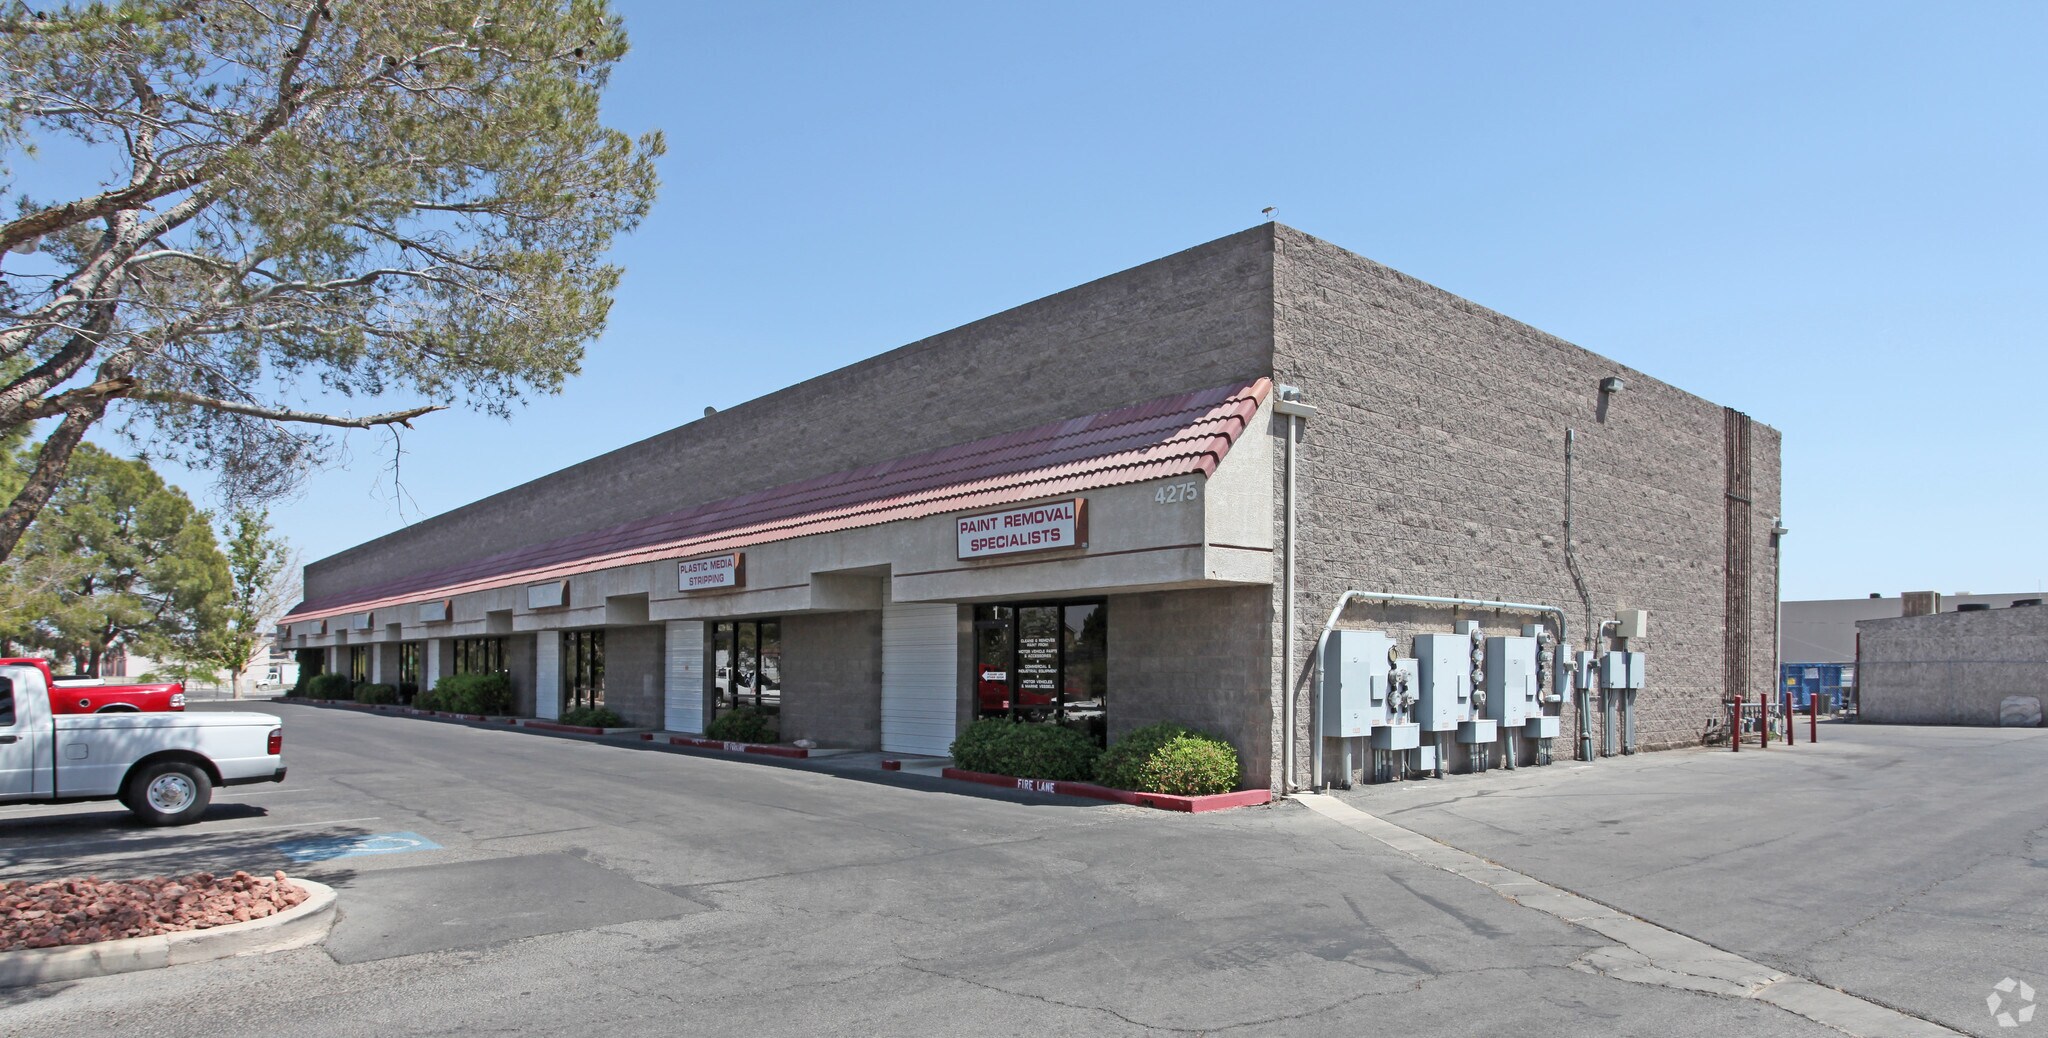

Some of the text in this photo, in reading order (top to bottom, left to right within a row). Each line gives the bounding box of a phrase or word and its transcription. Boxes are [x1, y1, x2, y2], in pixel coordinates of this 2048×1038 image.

[1155, 481, 1198, 505] 4275
[960, 506, 1073, 534] PAINT REMOVAL
[971, 528, 1060, 551] SPECIALISTS
[680, 558, 733, 574] PLASTIC MEDIA
[689, 573, 724, 586] STRIPPING
[993, 605, 998, 620] 1
[1018, 779, 1055, 793] FIRE LANE
